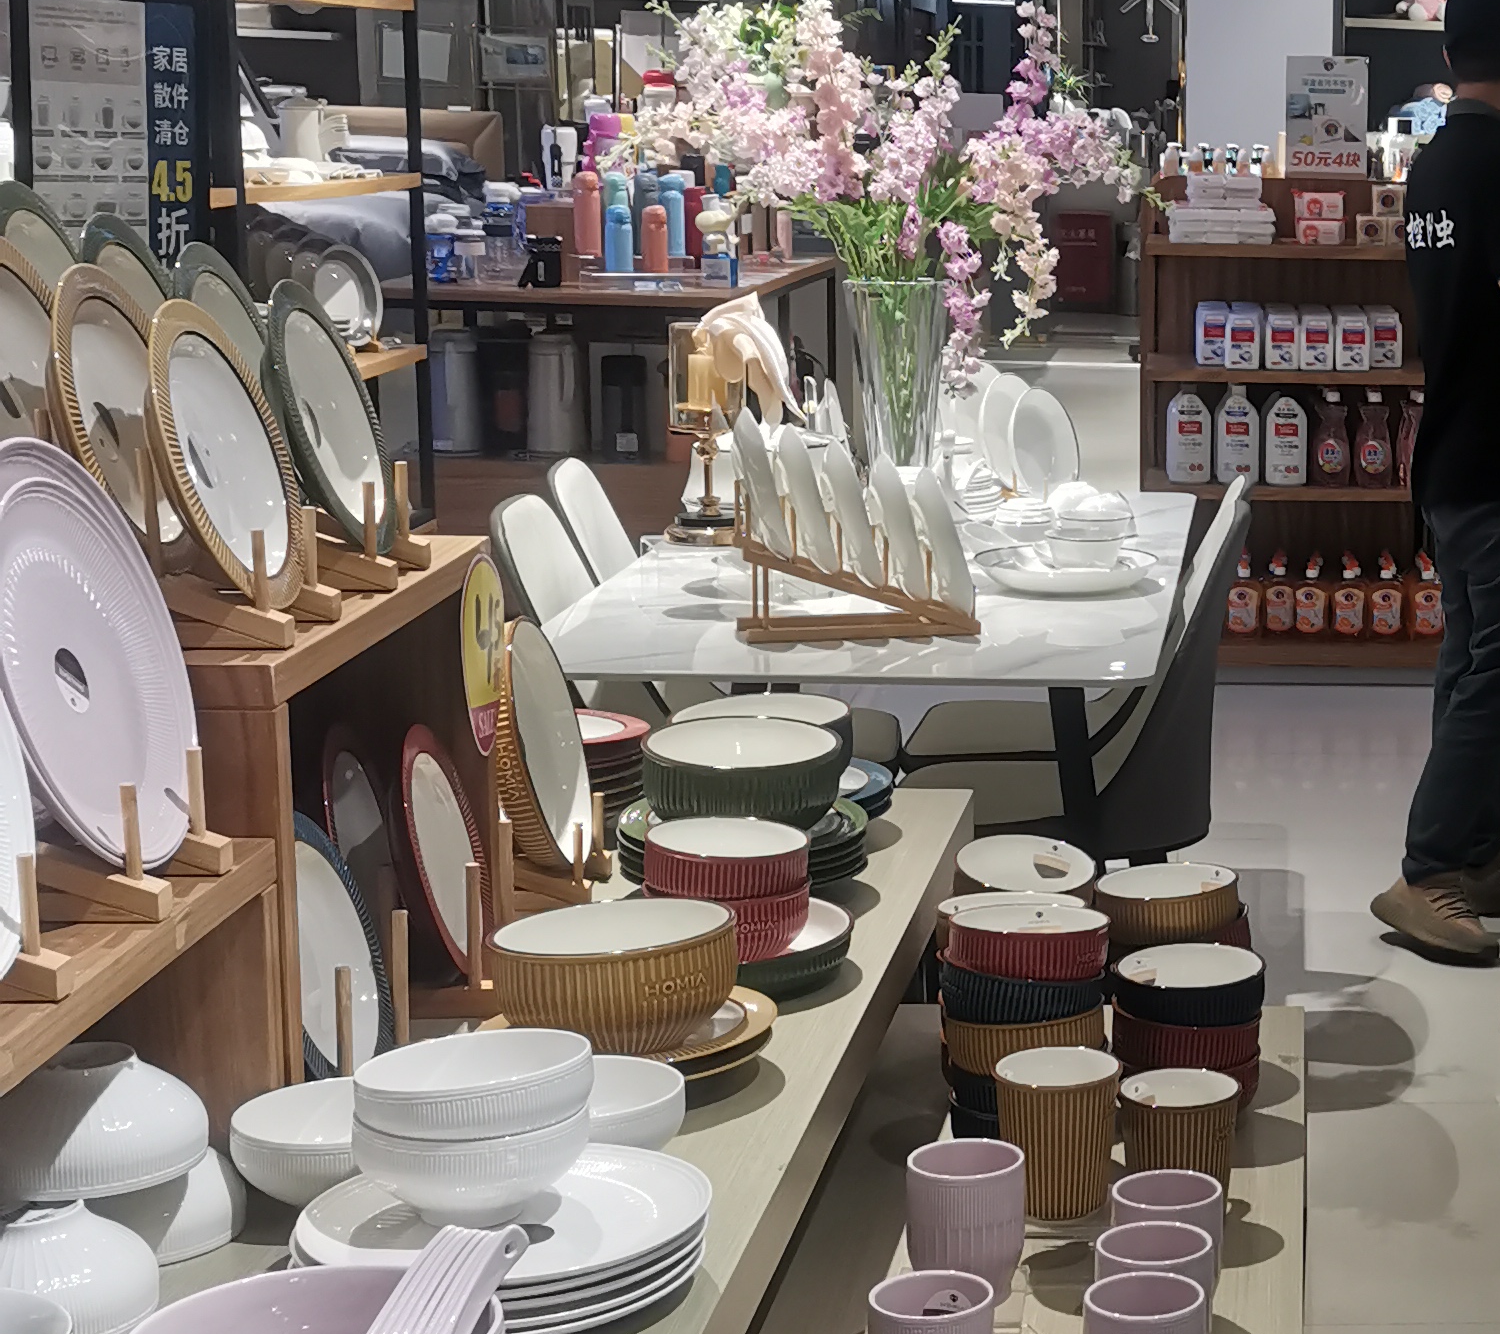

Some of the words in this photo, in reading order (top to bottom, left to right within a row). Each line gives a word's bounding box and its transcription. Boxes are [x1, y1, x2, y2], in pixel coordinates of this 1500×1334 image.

[151, 45, 189, 73] 家居
[152, 82, 190, 111] 散件
[153, 118, 190, 146] 清仓
[1290, 150, 1362, 168] 50元4块
[151, 159, 194, 204] 4.5
[157, 207, 191, 256] 折
[644, 971, 707, 998] HOMIA
